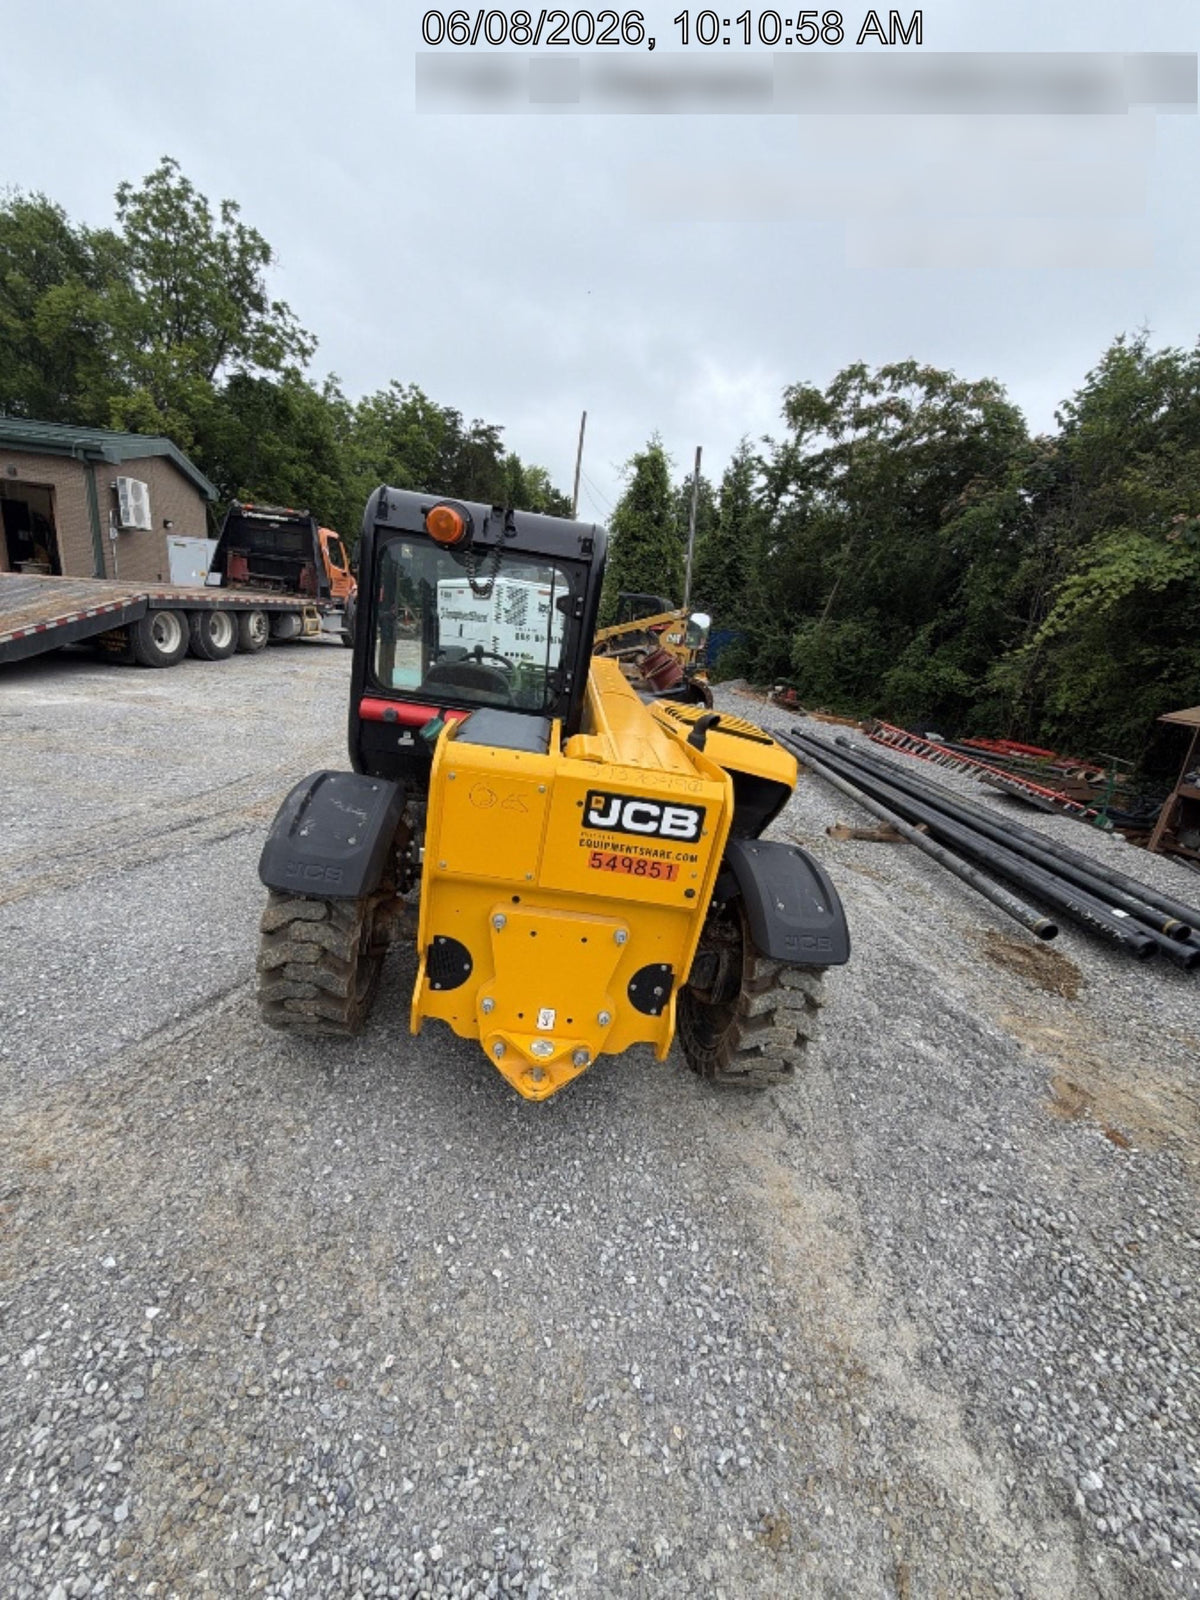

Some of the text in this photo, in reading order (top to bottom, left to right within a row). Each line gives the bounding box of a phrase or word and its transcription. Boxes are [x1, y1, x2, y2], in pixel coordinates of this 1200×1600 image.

[588, 797, 699, 838] JCB
[579, 838, 698, 863] EQUIPMENTSHARE.COM
[287, 861, 343, 882] JCB
[590, 852, 675, 880] 549851
[784, 934, 833, 952] JCB
